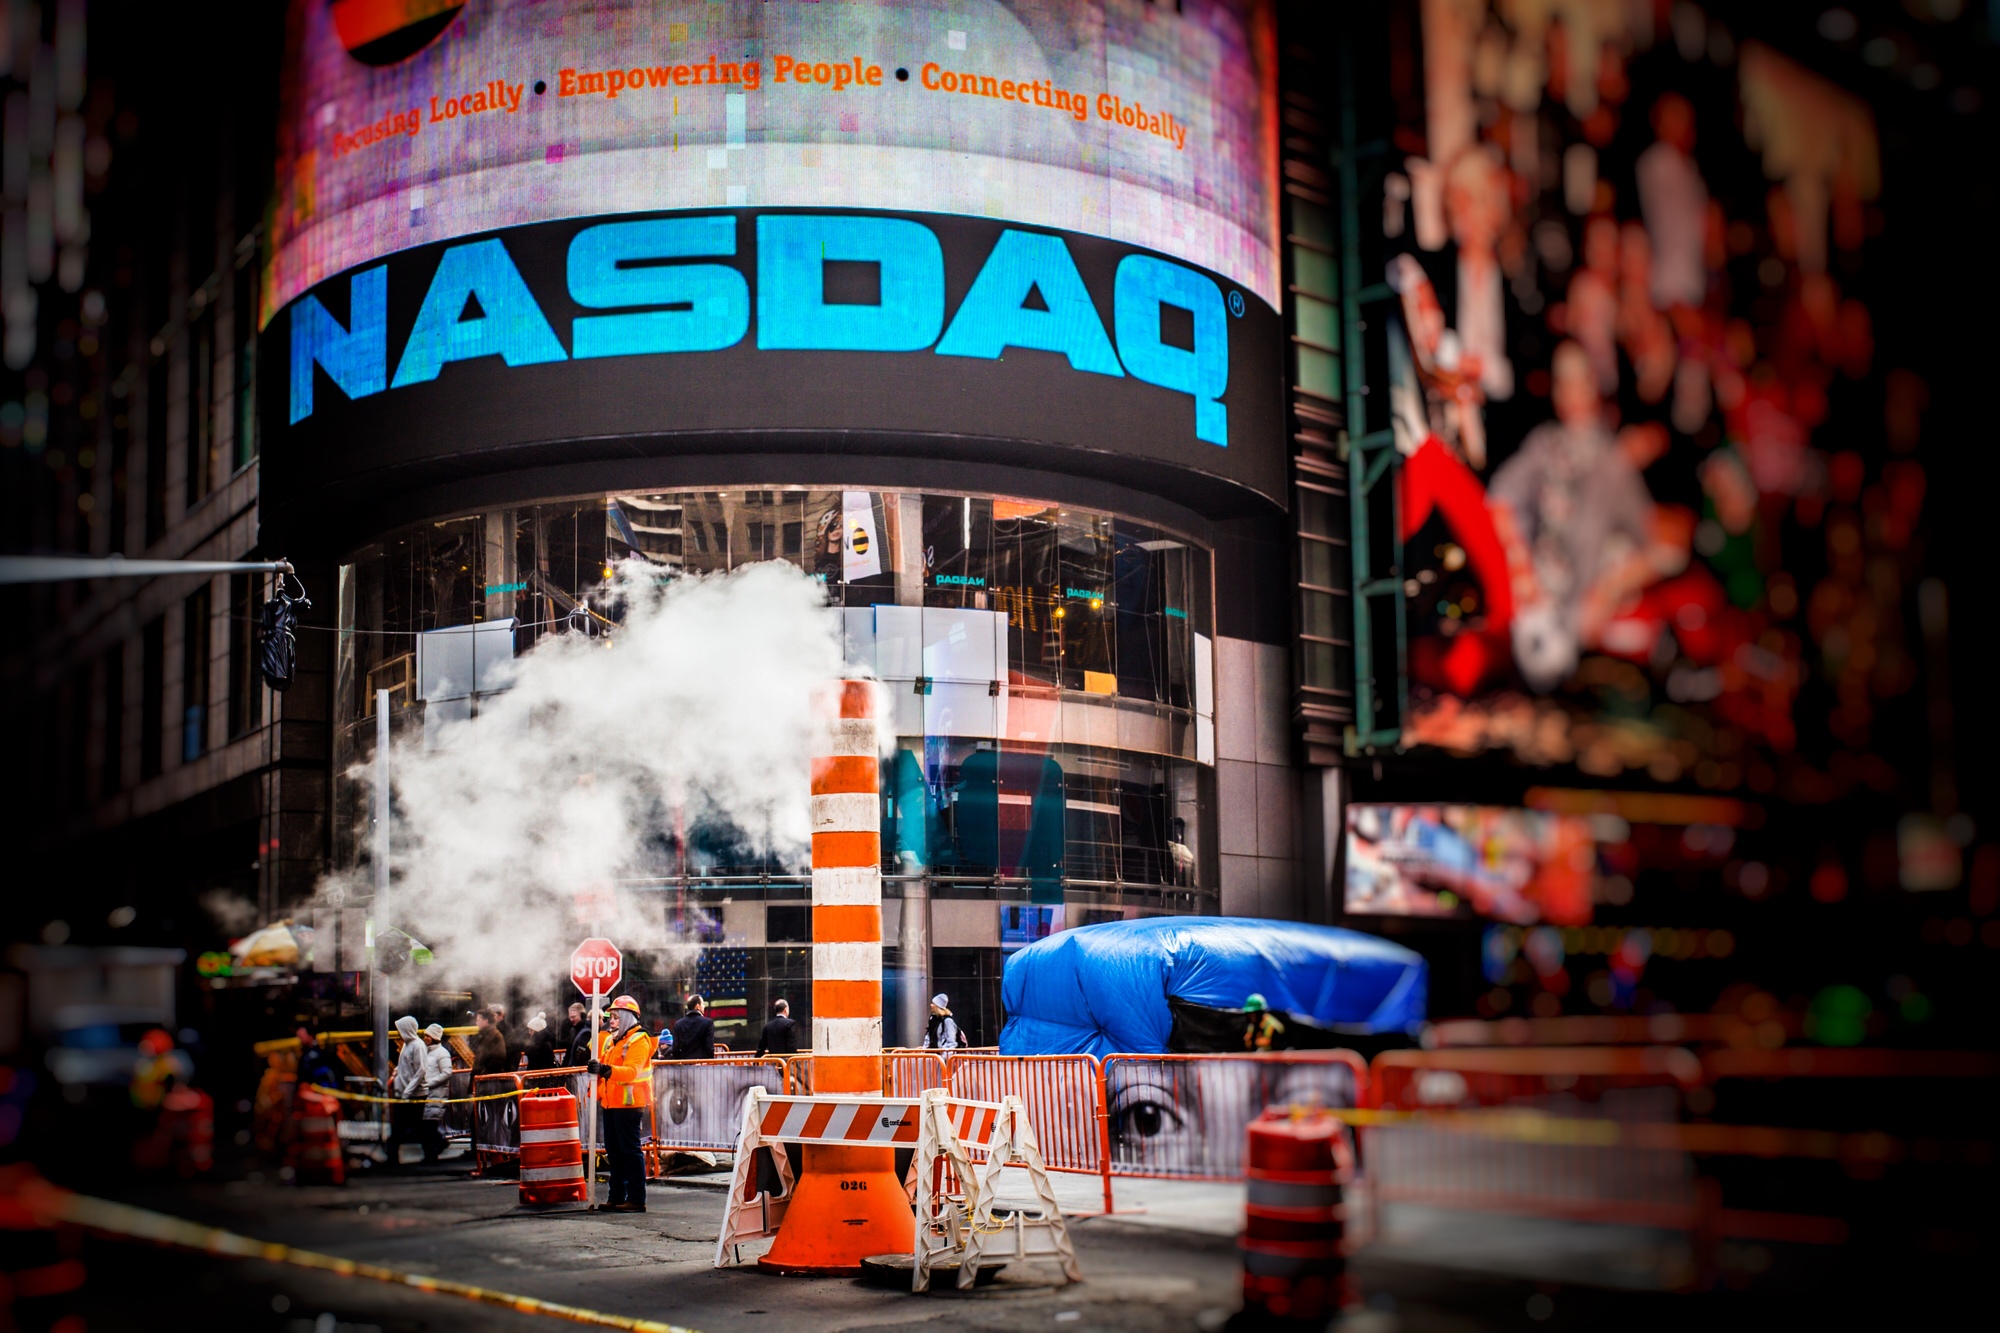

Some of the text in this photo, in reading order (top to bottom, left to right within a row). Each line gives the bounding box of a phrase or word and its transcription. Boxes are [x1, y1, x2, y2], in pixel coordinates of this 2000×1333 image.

[333, 54, 1187, 159] Focusing Locally Empowering People Connecting Globally
[574, 956, 619, 978] STOP
[840, 1180, 867, 1191] 026
